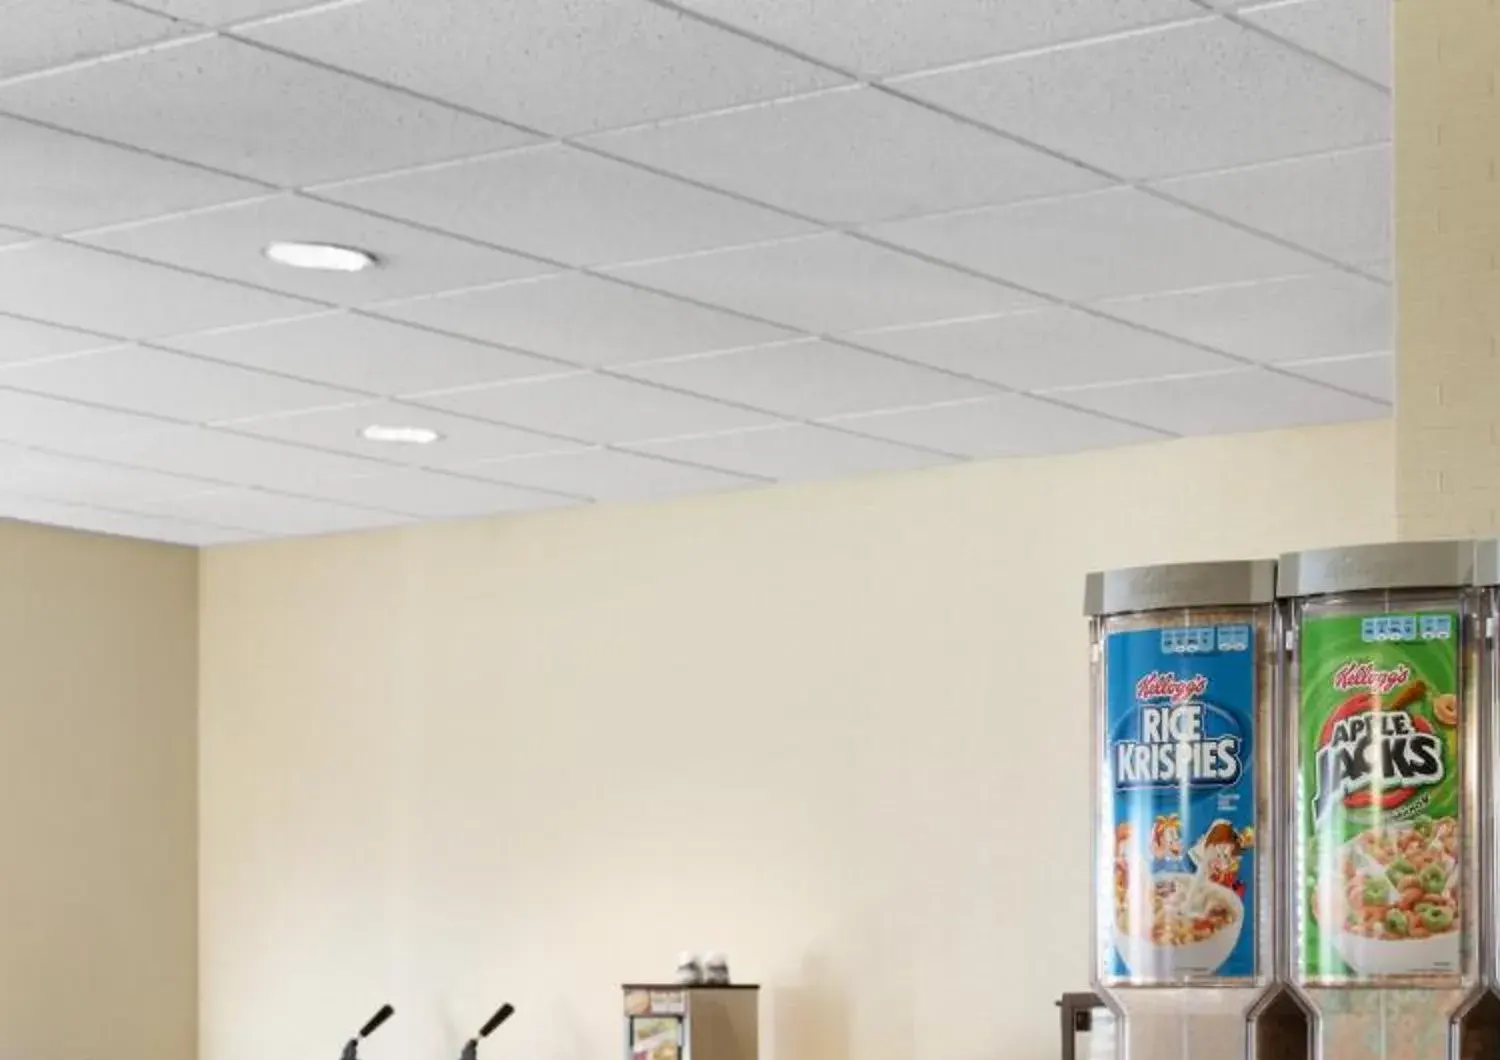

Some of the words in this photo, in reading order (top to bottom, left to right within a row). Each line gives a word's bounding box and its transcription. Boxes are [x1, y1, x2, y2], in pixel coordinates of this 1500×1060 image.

[1136, 671, 1207, 699] Kellogg's
[1333, 661, 1410, 694] Kellogg's
[1142, 706, 1204, 742] RICE
[1332, 713, 1411, 747] APPLE
[1117, 739, 1239, 782] KRISPIES
[1314, 734, 1440, 818] JACKS
